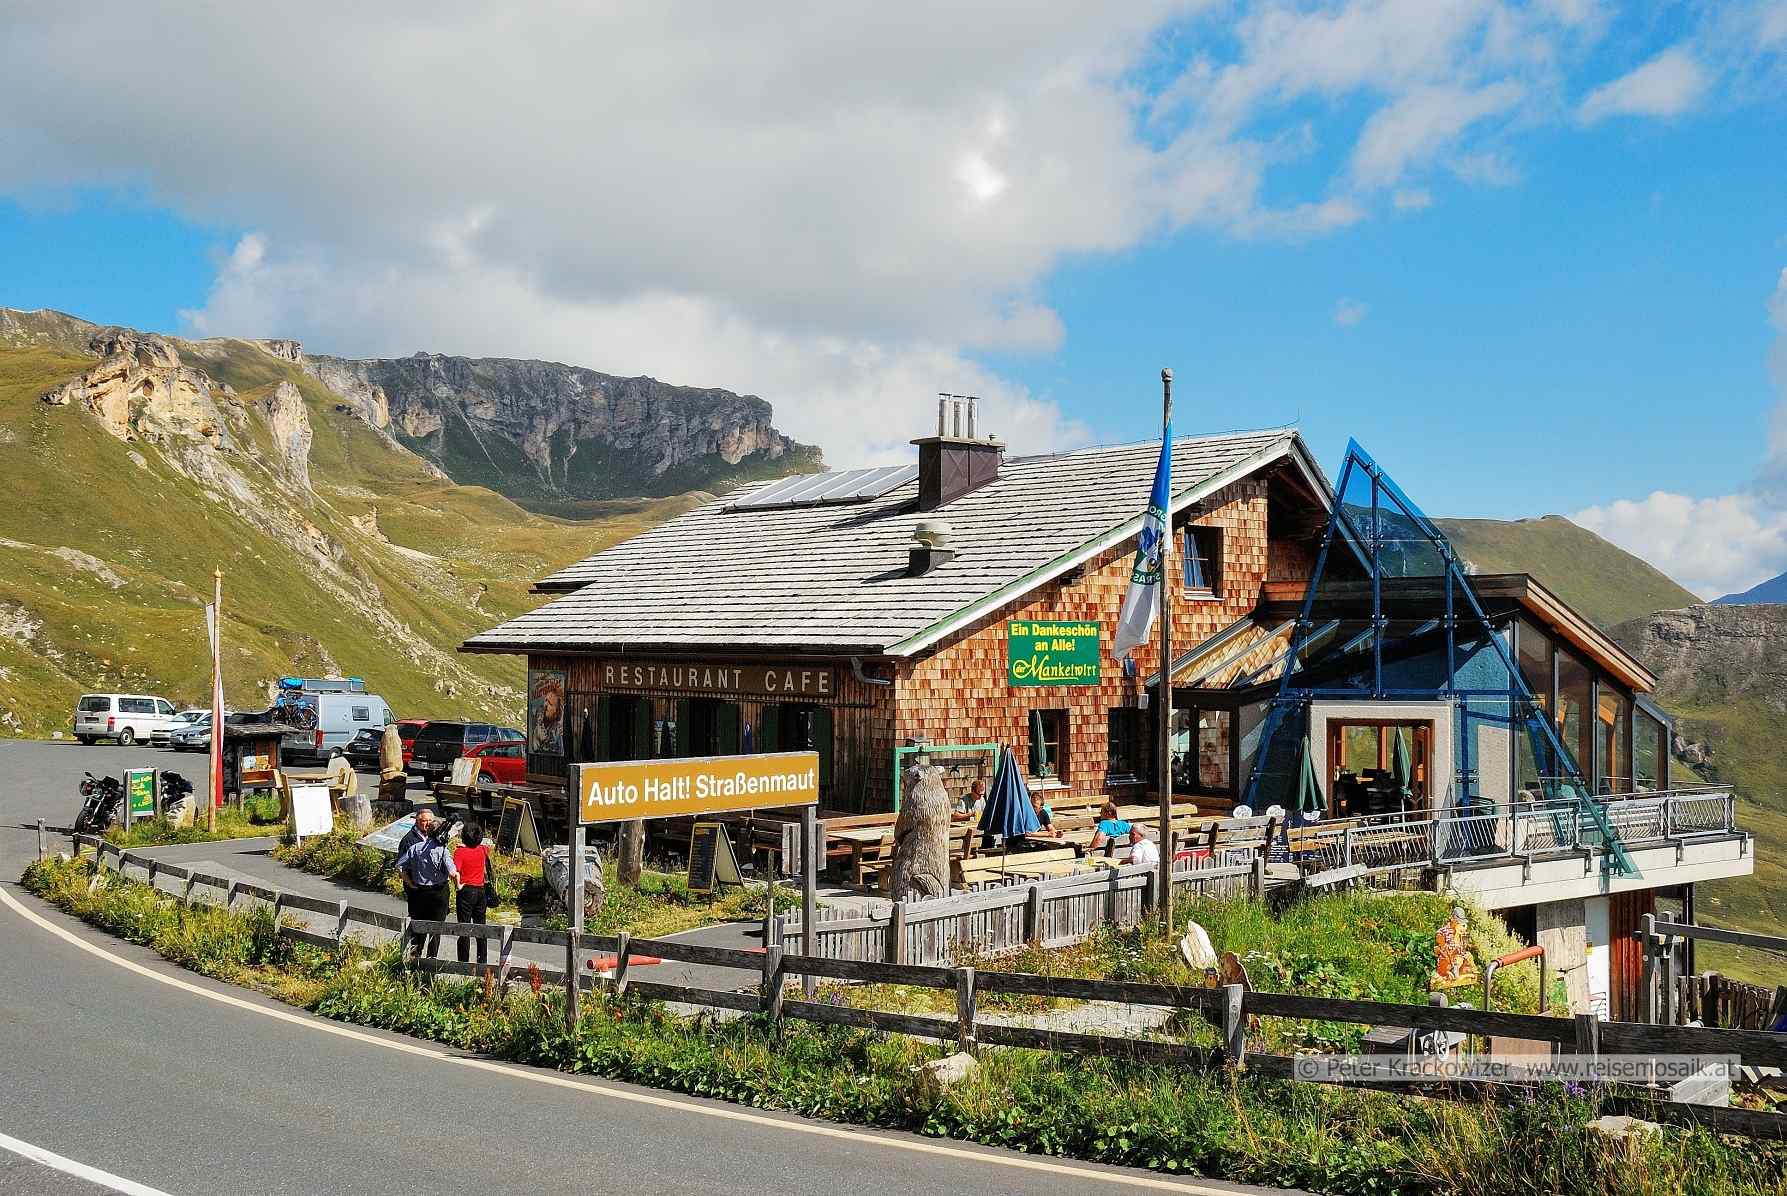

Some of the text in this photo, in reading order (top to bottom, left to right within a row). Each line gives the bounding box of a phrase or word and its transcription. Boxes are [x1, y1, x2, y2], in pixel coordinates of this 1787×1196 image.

[1011, 624, 1097, 636] Ein Dankeschön
[1035, 639, 1075, 651] an Alle!
[606, 665, 829, 692] RESTAURANT CAFE
[588, 768, 815, 806] Auto Halt! Straßenmaut
